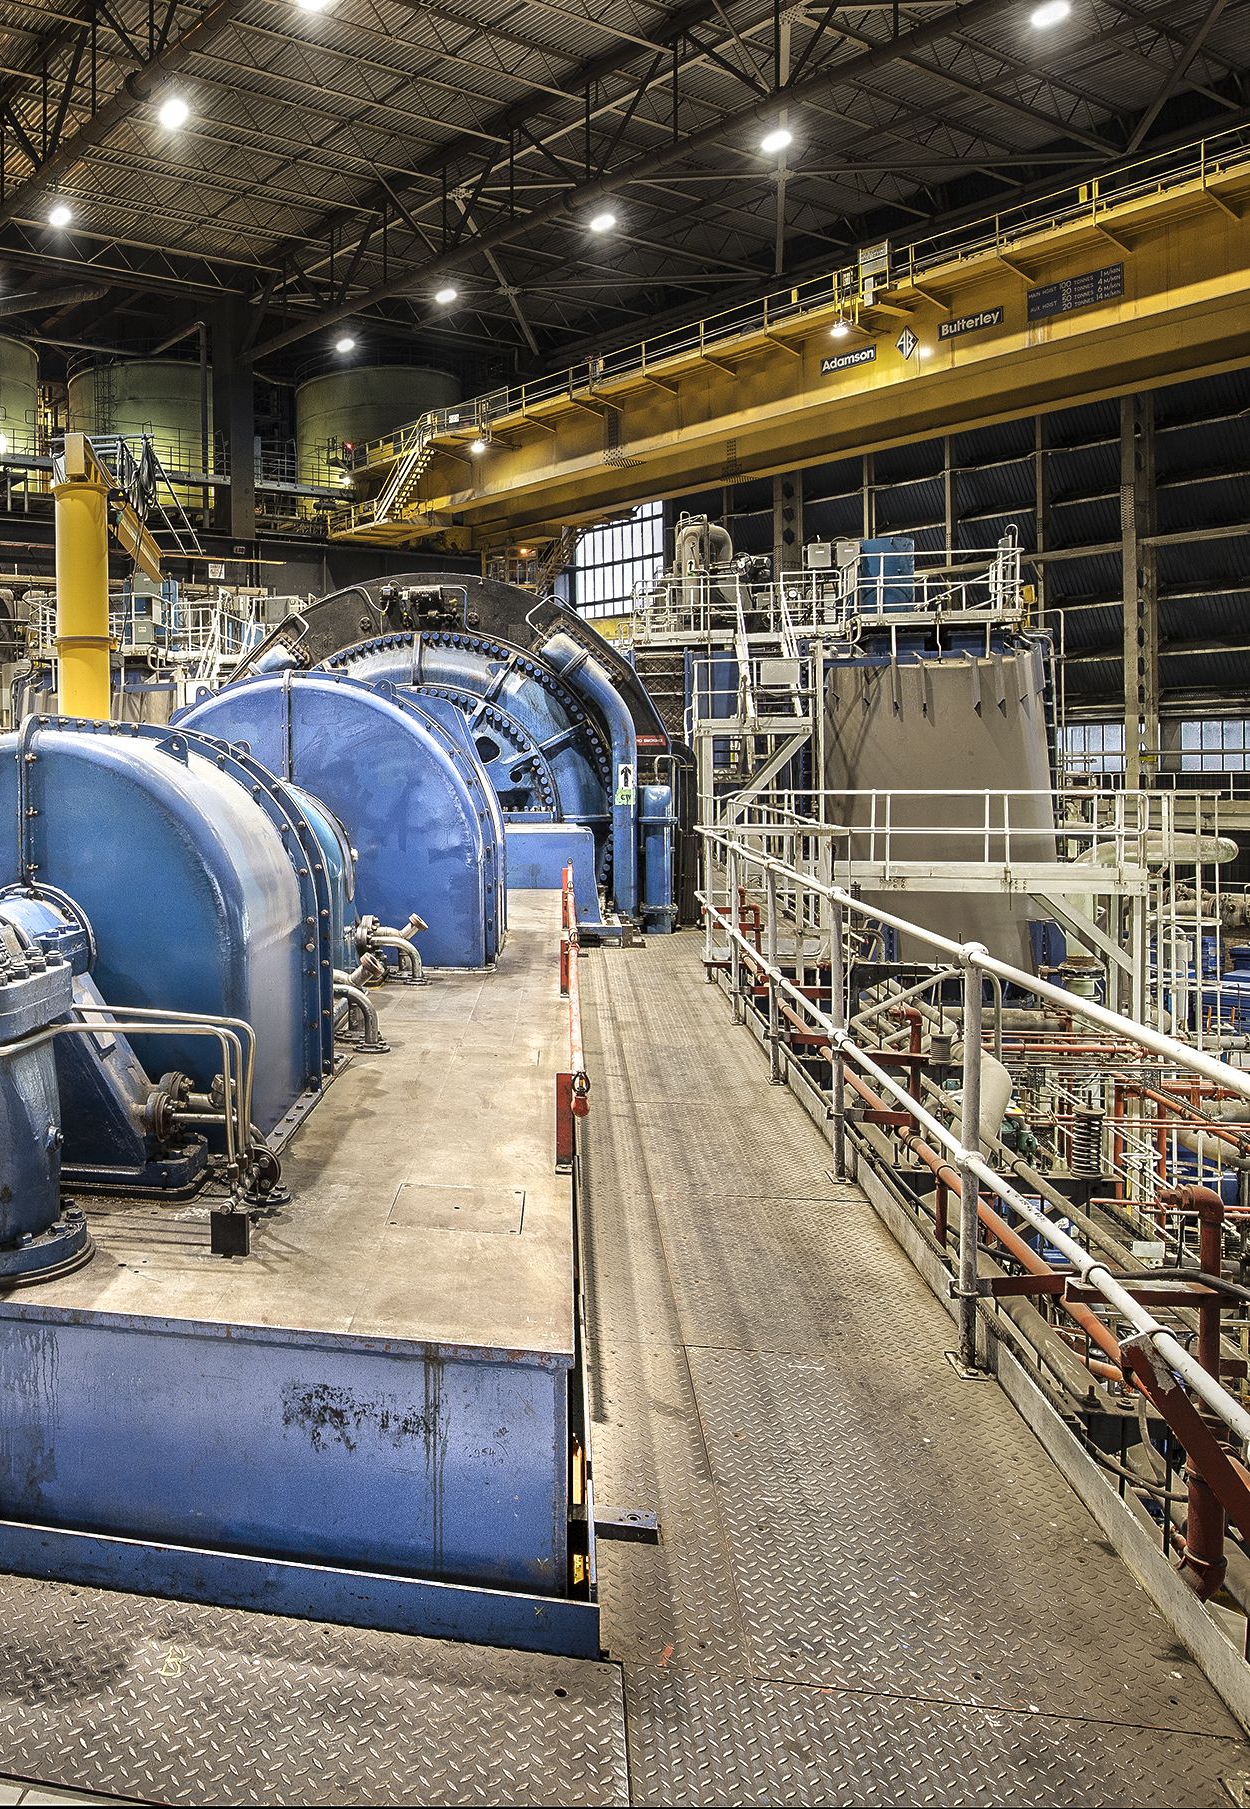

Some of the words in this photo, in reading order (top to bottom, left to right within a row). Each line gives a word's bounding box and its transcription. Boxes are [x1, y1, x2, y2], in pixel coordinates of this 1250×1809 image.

[1059, 280, 1072, 290] 100
[1074, 275, 1094, 285] TONNES
[1061, 288, 1072, 297] 20
[1074, 283, 1094, 292] TONNES
[1061, 295, 1072, 304] 50
[1074, 290, 1094, 300] TONNES
[1062, 302, 1073, 311] 20
[1074, 297, 1095, 307] TONNES
[941, 311, 1000, 337] Butterley
[822, 349, 874, 372] Adamson
